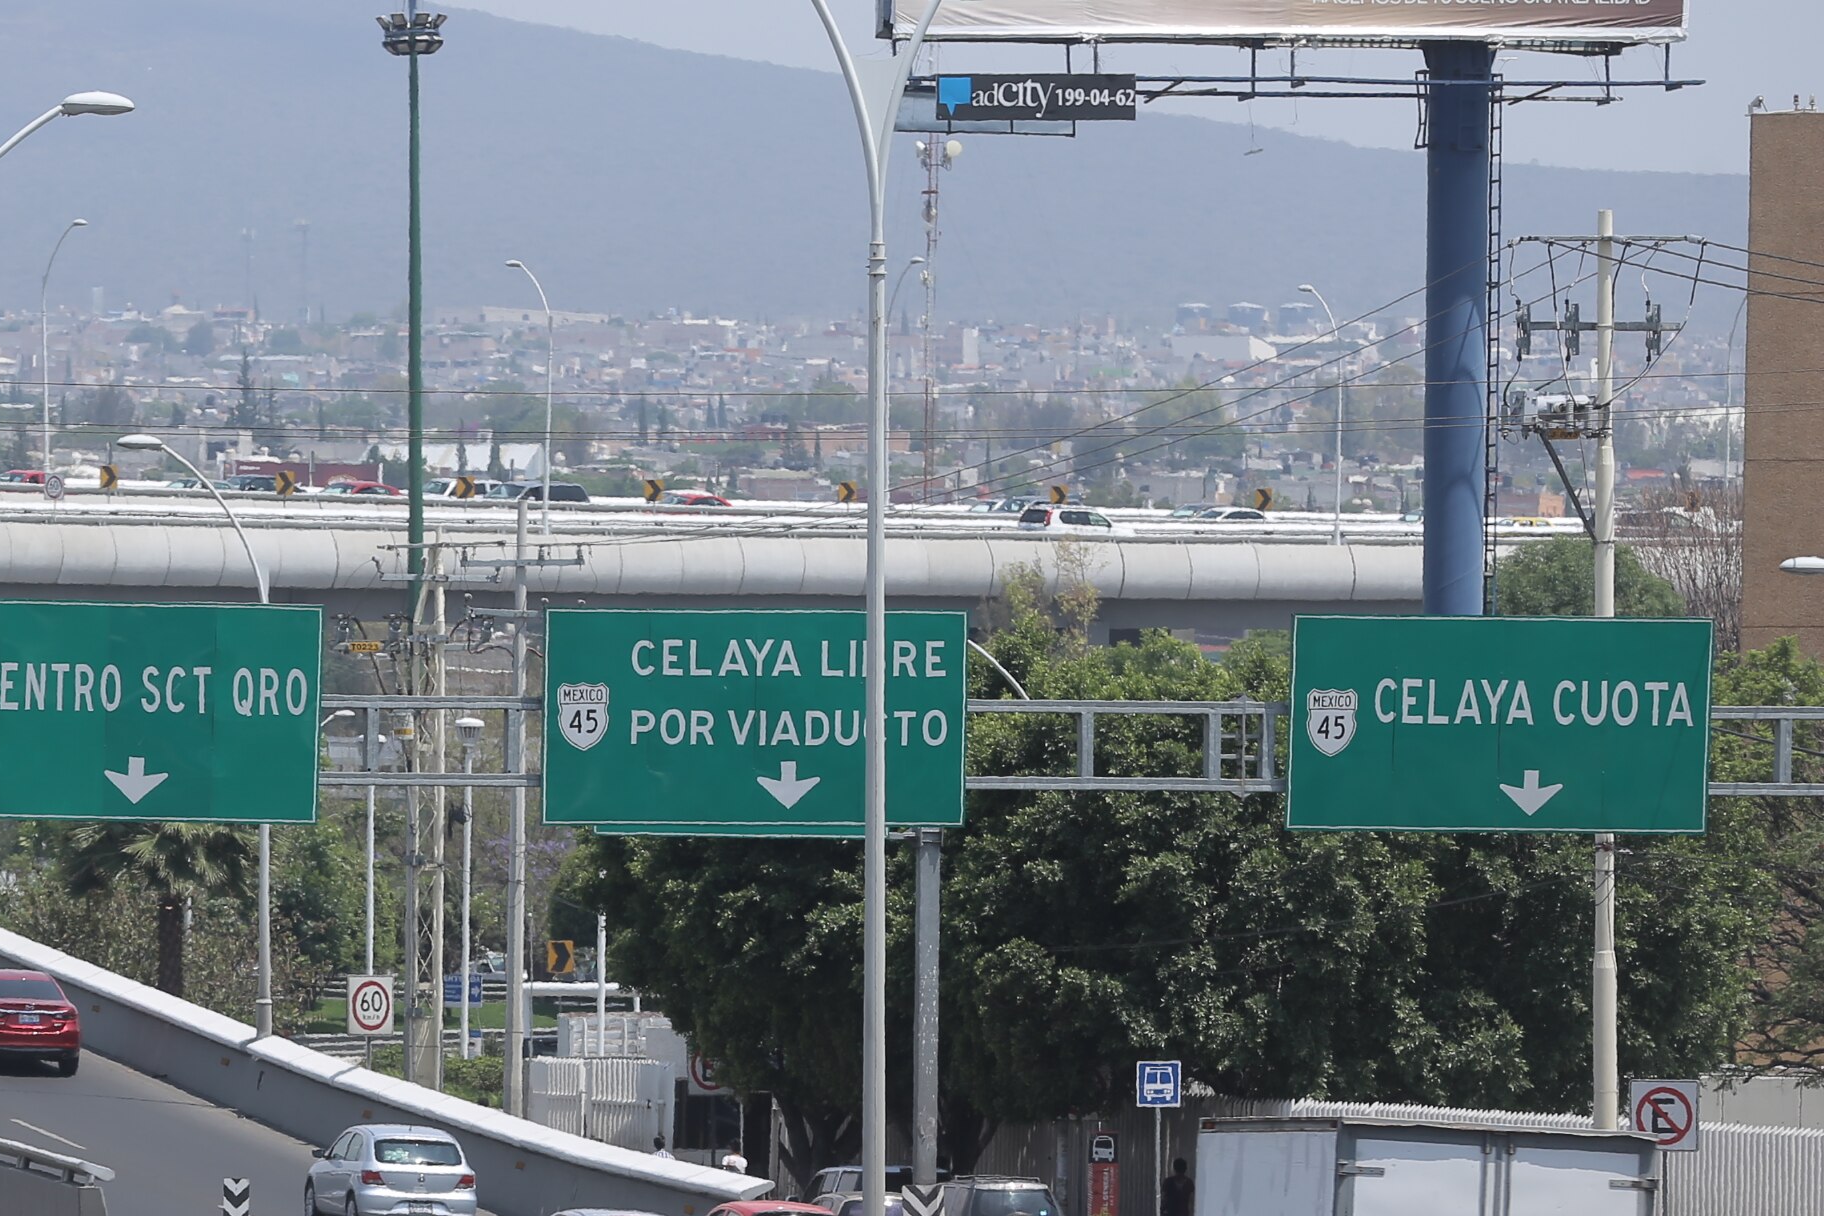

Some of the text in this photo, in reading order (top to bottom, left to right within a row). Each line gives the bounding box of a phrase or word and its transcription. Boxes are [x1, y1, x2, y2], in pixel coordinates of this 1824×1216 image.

[1055, 89, 1135, 106] 199-04-62
[631, 639, 947, 677] CELAYA LIRE
[141, 666, 212, 714] SCT
[232, 668, 308, 716] QRO
[563, 688, 604, 702] MEXICO
[1313, 695, 1352, 708] MEXICO
[1375, 678, 1694, 727] CELAYA CUOTA
[569, 710, 598, 734] 45
[630, 709, 715, 746] POR
[1317, 715, 1346, 740] 45
[360, 991, 383, 1012] 60
